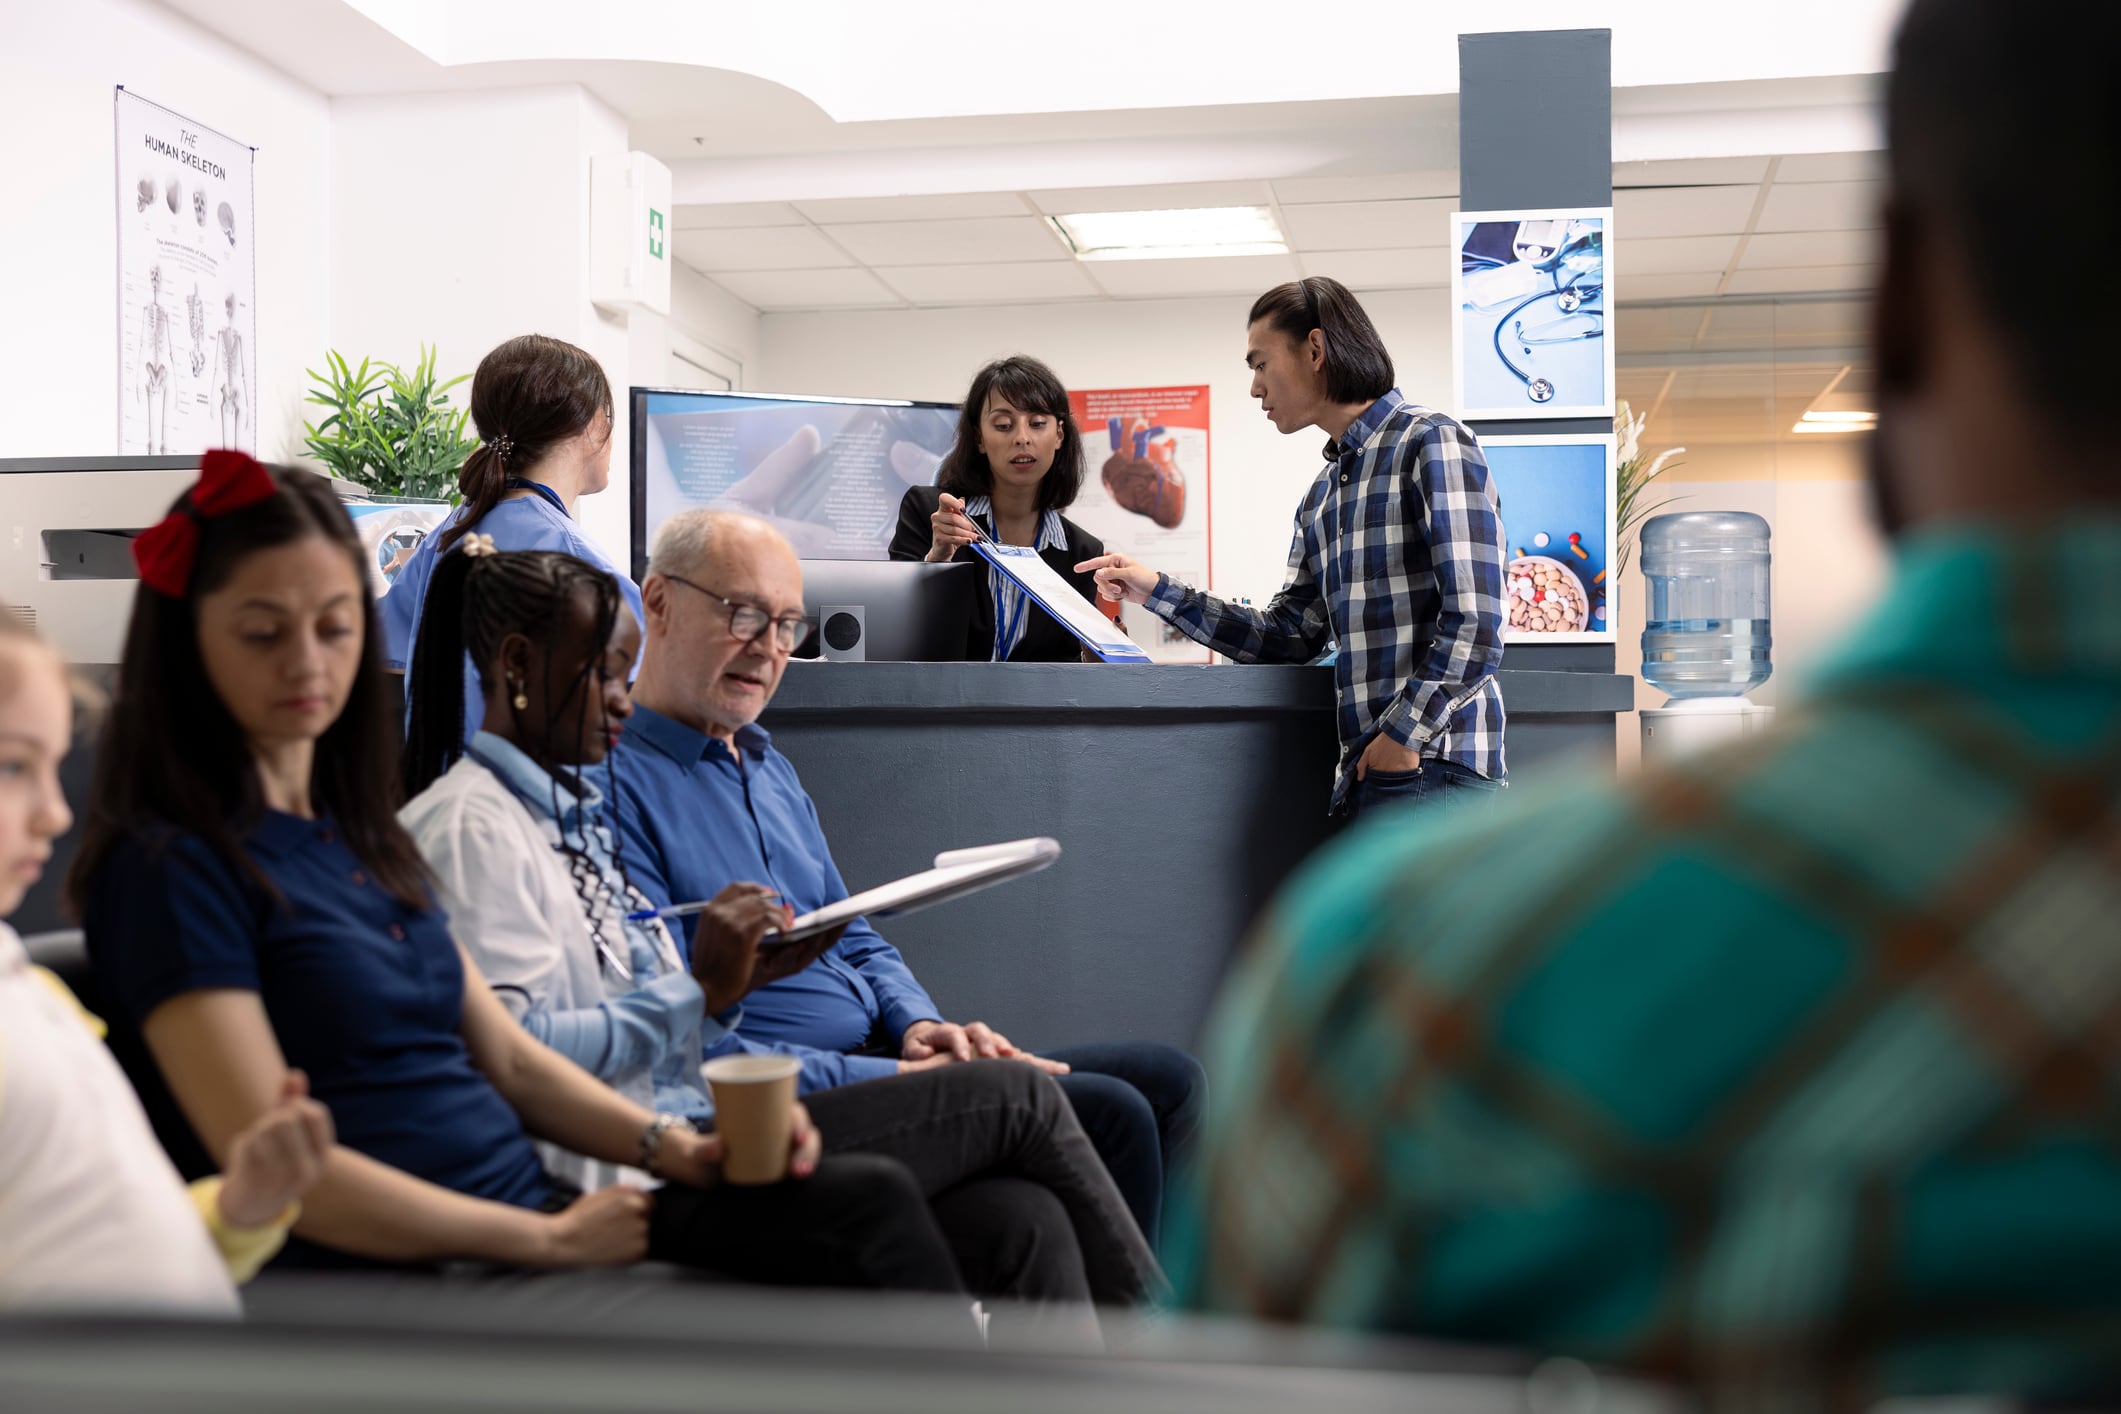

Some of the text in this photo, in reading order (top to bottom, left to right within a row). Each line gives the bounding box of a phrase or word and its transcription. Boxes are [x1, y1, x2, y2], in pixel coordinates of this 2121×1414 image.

[180, 129, 198, 149] THE
[145, 133, 226, 181] HUMAN SKELETON
